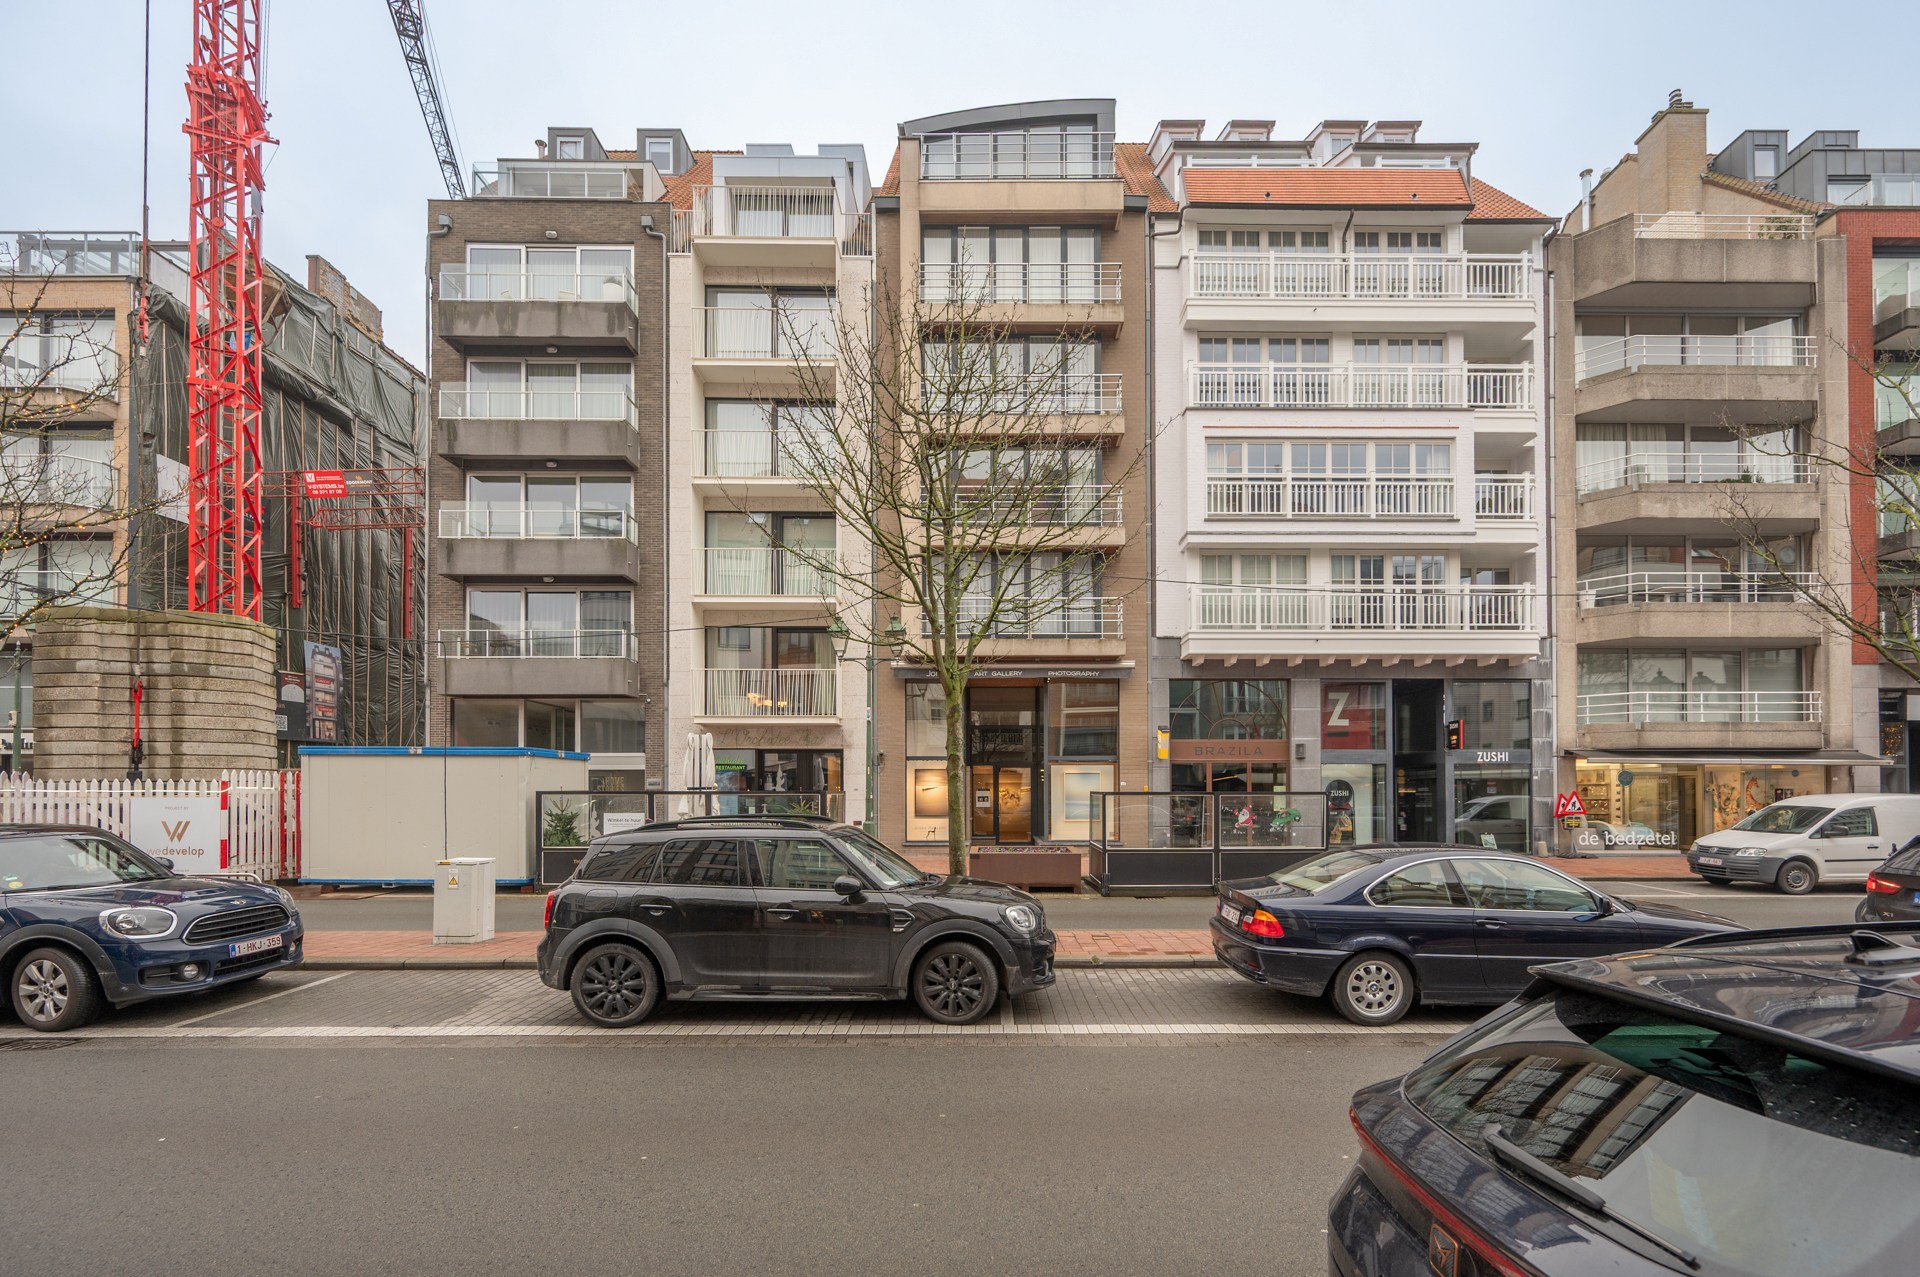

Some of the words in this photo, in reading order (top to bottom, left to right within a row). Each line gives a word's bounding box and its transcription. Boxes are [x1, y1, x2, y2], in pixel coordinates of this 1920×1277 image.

[1327, 692, 1350, 726] Z
[1194, 746, 1263, 756] BRAZILA
[1477, 751, 1509, 762] ZUSHI
[605, 776, 625, 785] HOME
[1579, 831, 1599, 845] de
[1605, 831, 1677, 846] bedzetel
[146, 846, 205, 858] wedevelop
[237, 936, 281, 954] 1-HKJ-359
